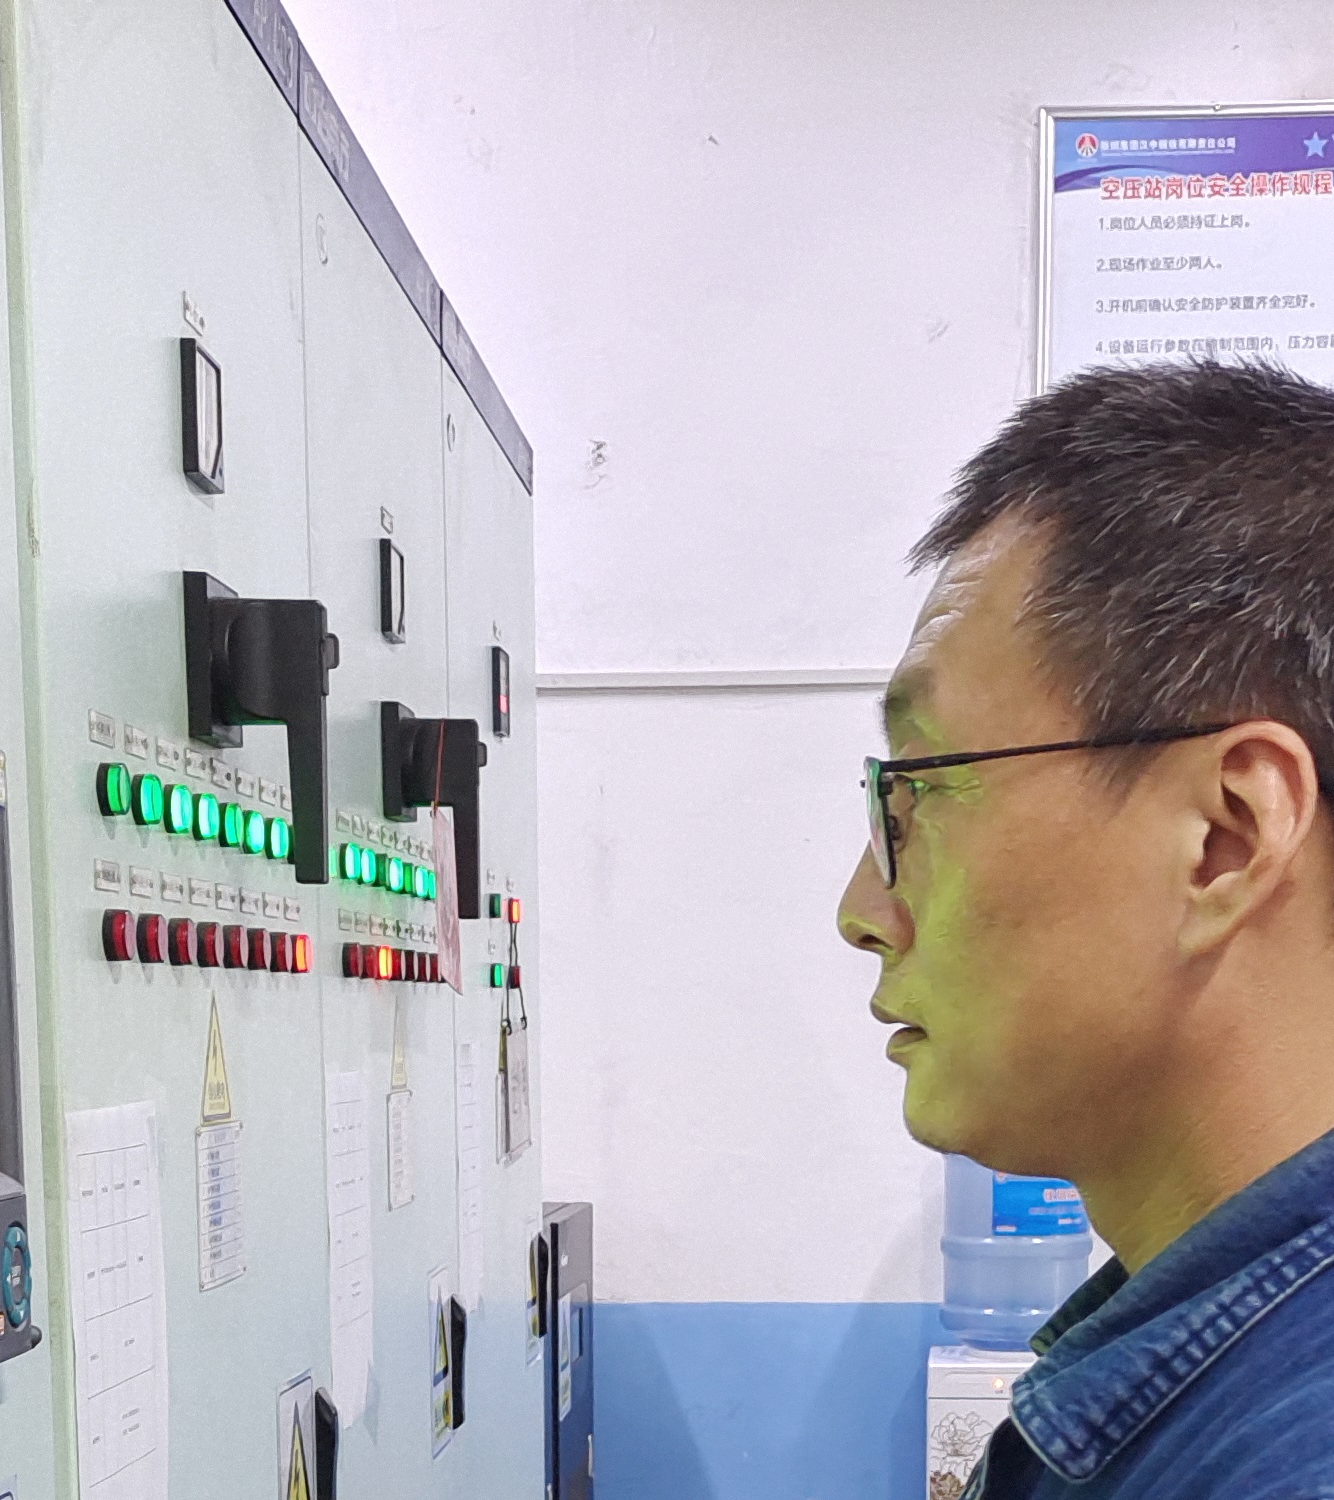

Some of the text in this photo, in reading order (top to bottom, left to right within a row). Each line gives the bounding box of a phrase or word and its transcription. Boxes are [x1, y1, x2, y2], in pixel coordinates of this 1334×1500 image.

[1101, 172, 1333, 199] 空压站岗位安全操作规程
